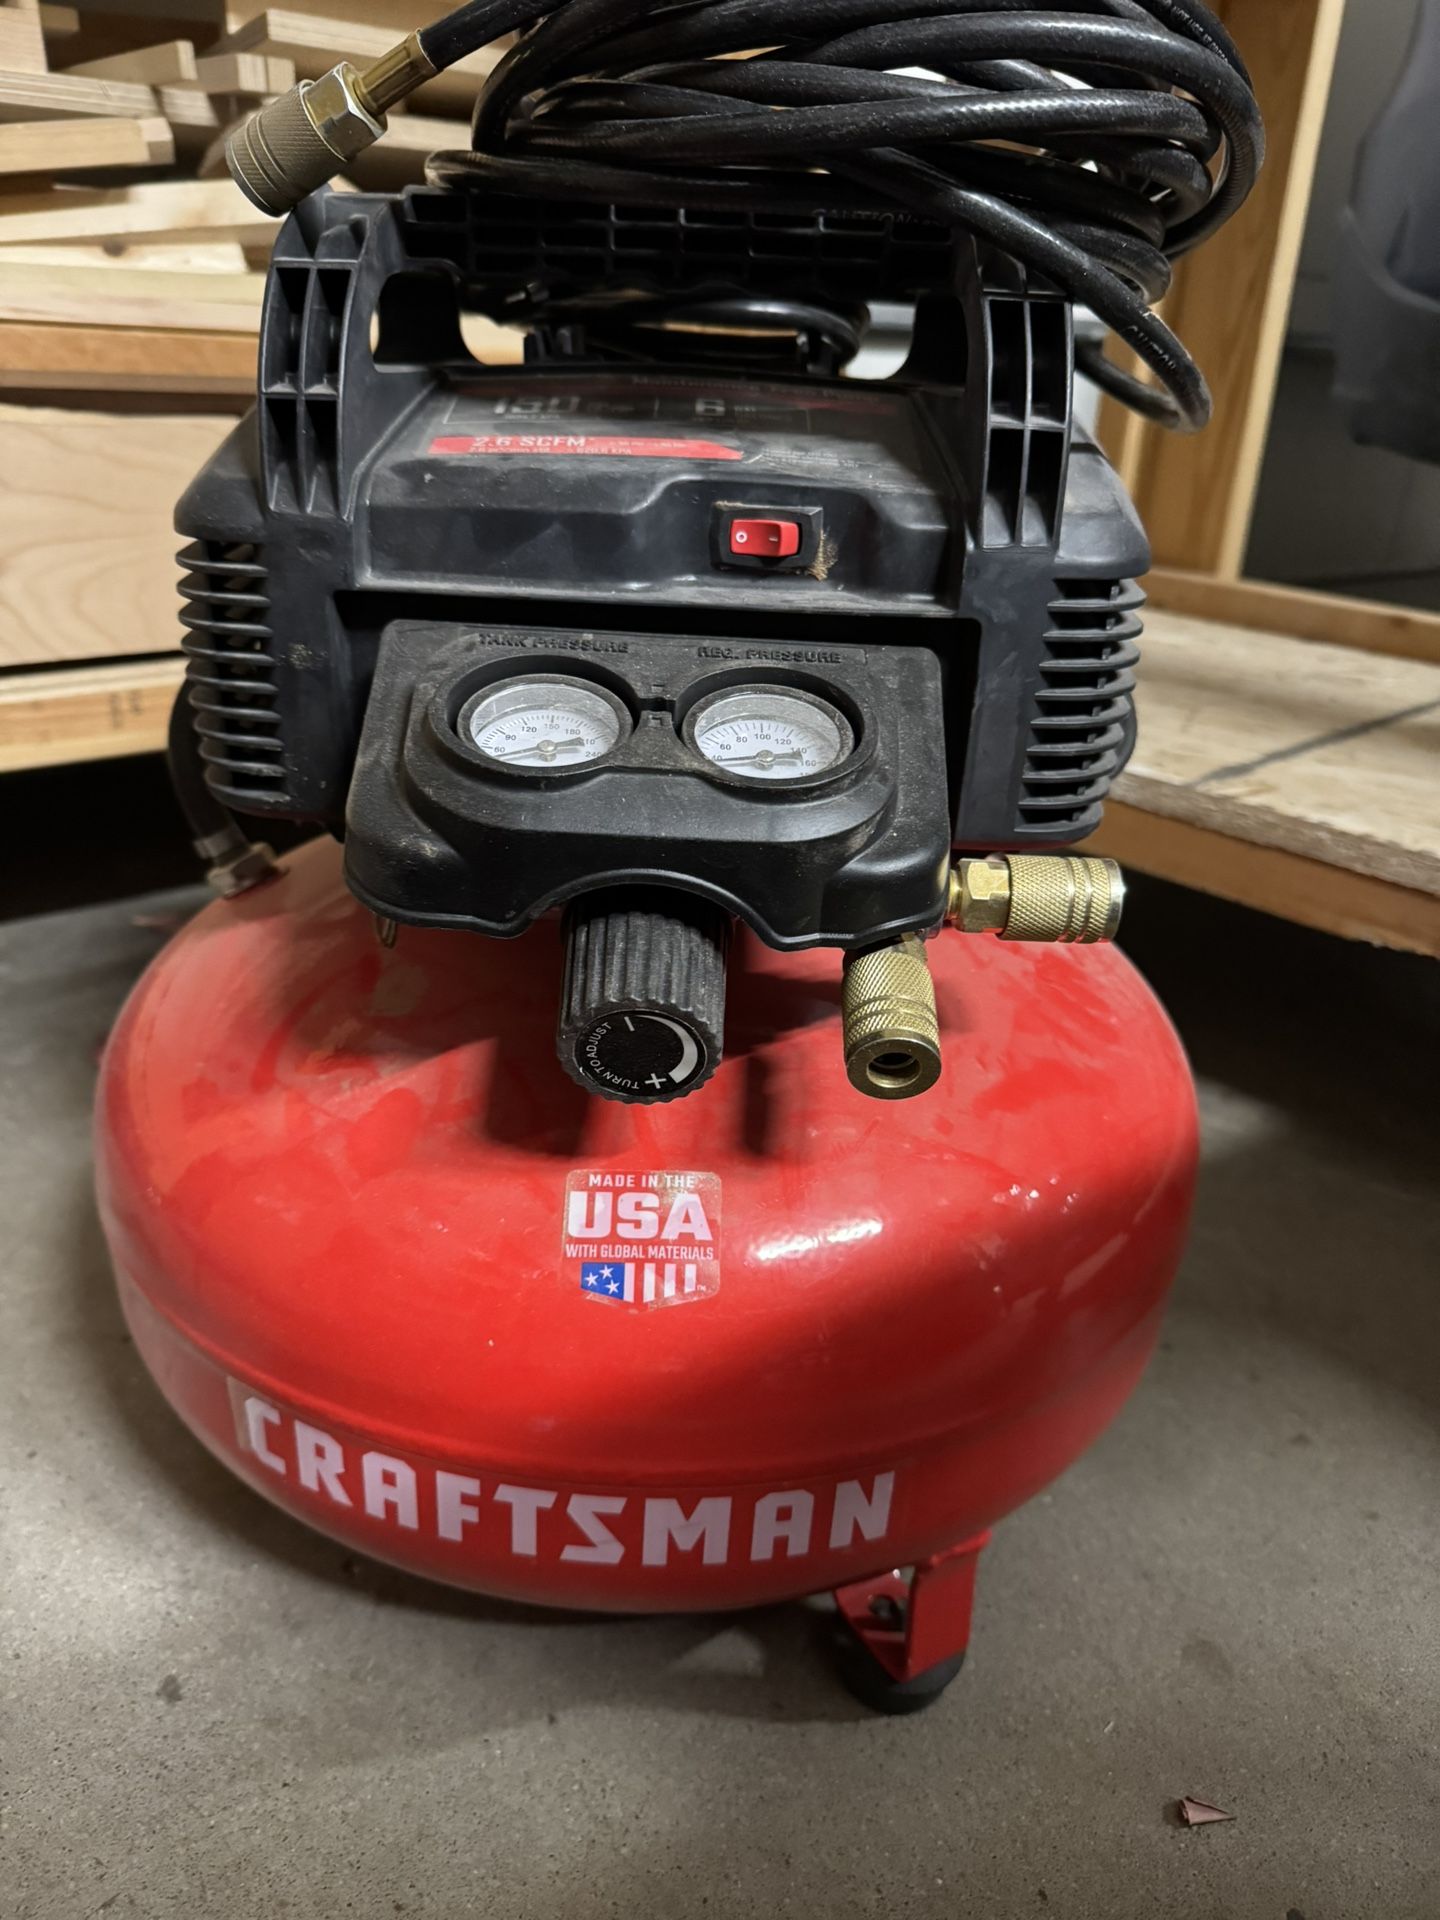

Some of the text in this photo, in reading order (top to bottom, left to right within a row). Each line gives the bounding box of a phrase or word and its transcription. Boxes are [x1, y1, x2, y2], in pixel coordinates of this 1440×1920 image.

[472, 436, 587, 447] 2.6 SCFM
[479, 633, 629, 654] TANK PRESSURE
[745, 649, 842, 664] PRESSURE
[736, 735, 748, 743] 80
[754, 732, 771, 740] 100
[585, 1021, 640, 1090] TURN TO ADJUST
[588, 1174, 696, 1189] MADE IN THE
[567, 1191, 714, 1241] USA
[565, 1243, 714, 1261] WITH GLOBAL MATERIALS
[243, 1396, 896, 1567] CRAFTSMAN
